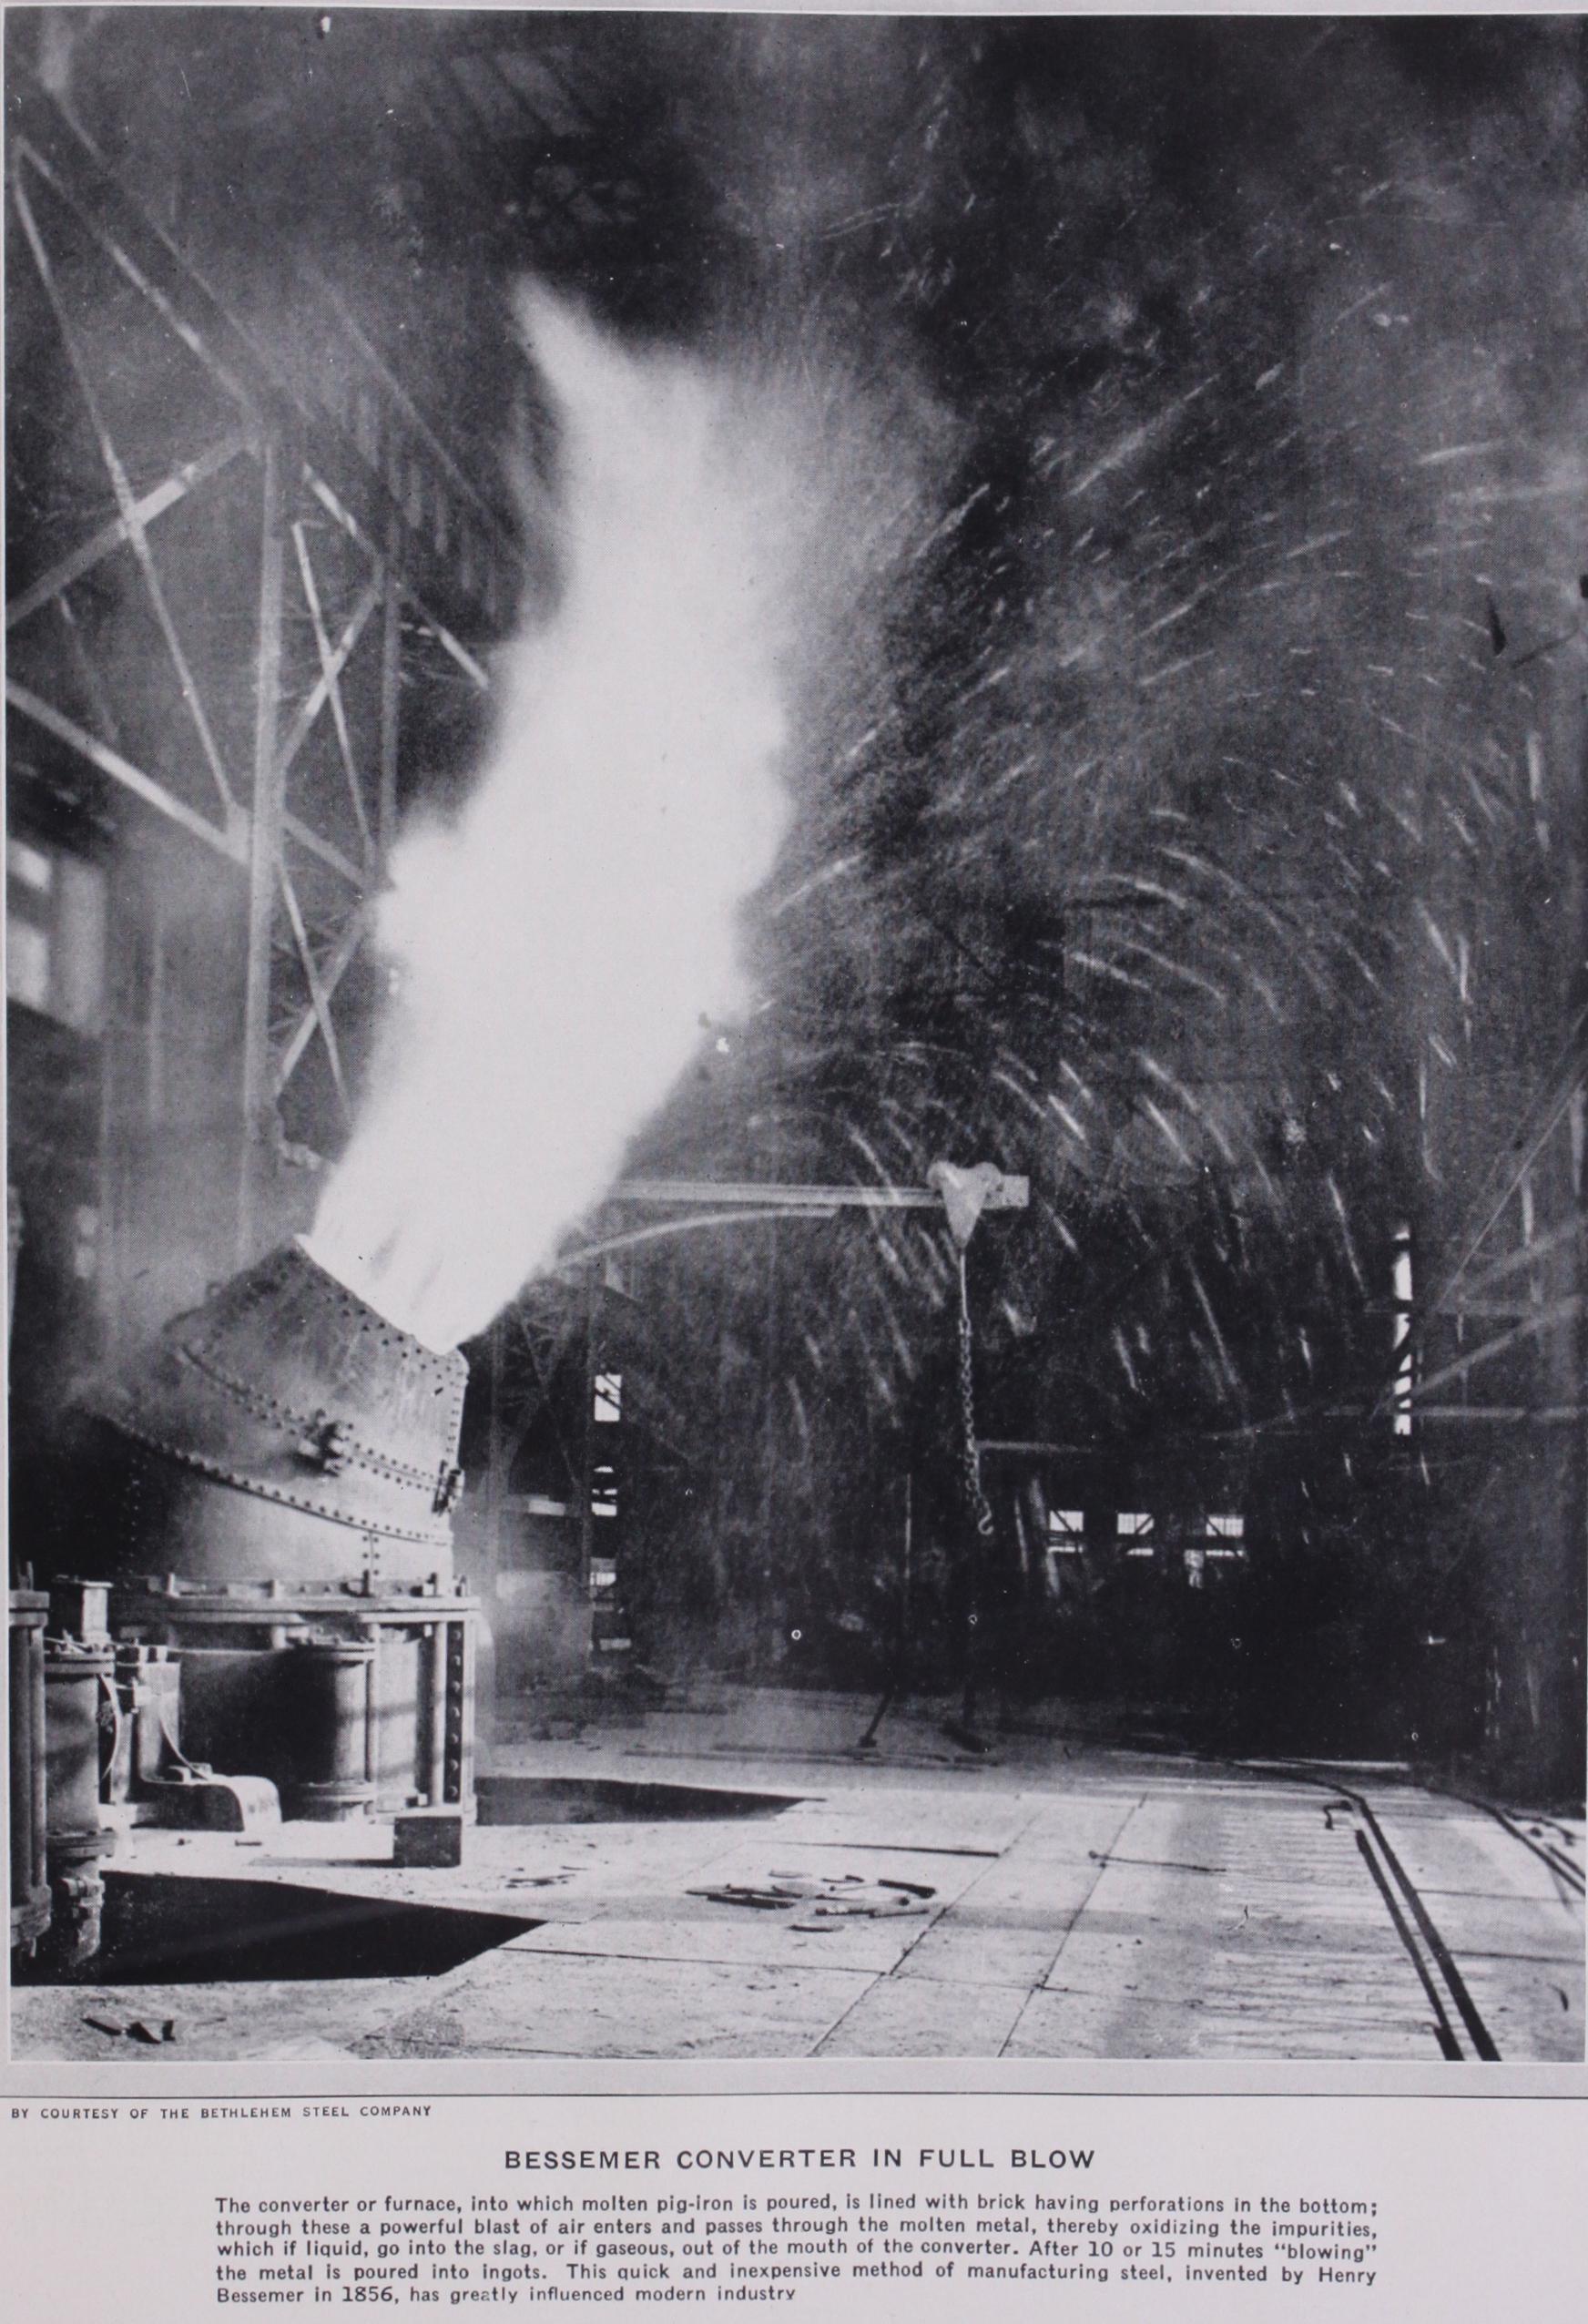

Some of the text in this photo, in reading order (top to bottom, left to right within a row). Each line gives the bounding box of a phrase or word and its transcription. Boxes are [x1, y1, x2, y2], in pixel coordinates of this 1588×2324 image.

[11, 2105, 432, 2120] BY COURTESY OF THE BETHLEHEM STEEL COMPANY
[504, 2148, 1095, 2170] BESSEMER CONVERTER IN FULL BLOW
[214, 2192, 1378, 2217] The converter or furnace, into which molten pig-iron is poured, is lined with brick having perforations in the bottom;
[215, 2216, 1377, 2240] through these a powerful blast of air enters and passes through the molten metal, thereby oxidizing the impurities,
[217, 2240, 274, 2257] which
[283, 2239, 298, 2257] if
[306, 2239, 369, 2258] liquid,
[377, 2243, 401, 2259] go
[408, 2238, 446, 2256] into
[453, 2238, 485, 2256] the
[493, 2238, 537, 2258] slag,
[545, 2243, 565, 2256] or
[574, 2238, 588, 2256] if
[596, 2243, 675, 2258] gaseous,
[682, 2239, 714, 2256] out
[722, 2238, 741, 2256] of
[748, 2238, 779, 2256] the
[787, 2237, 848, 2255] mouth
[856, 2237, 874, 2254] of
[883, 2237, 914, 2254] the
[920, 2238, 1019, 2256] converter.
[1028, 2239, 1079, 2257] After
[1088, 2240, 1114, 2258] 10
[1123, 2245, 1143, 2258] or
[1151, 2241, 1176, 2258] 15
[1187, 2241, 1264, 2259] minutes
[216, 2260, 1377, 2287] the metal is poured into ingots. This quick and inexpensive method of manufacturing steel, invented by Henry
[217, 2285, 796, 2306] Bessemer in 1856, has greatly influenced modern industry
